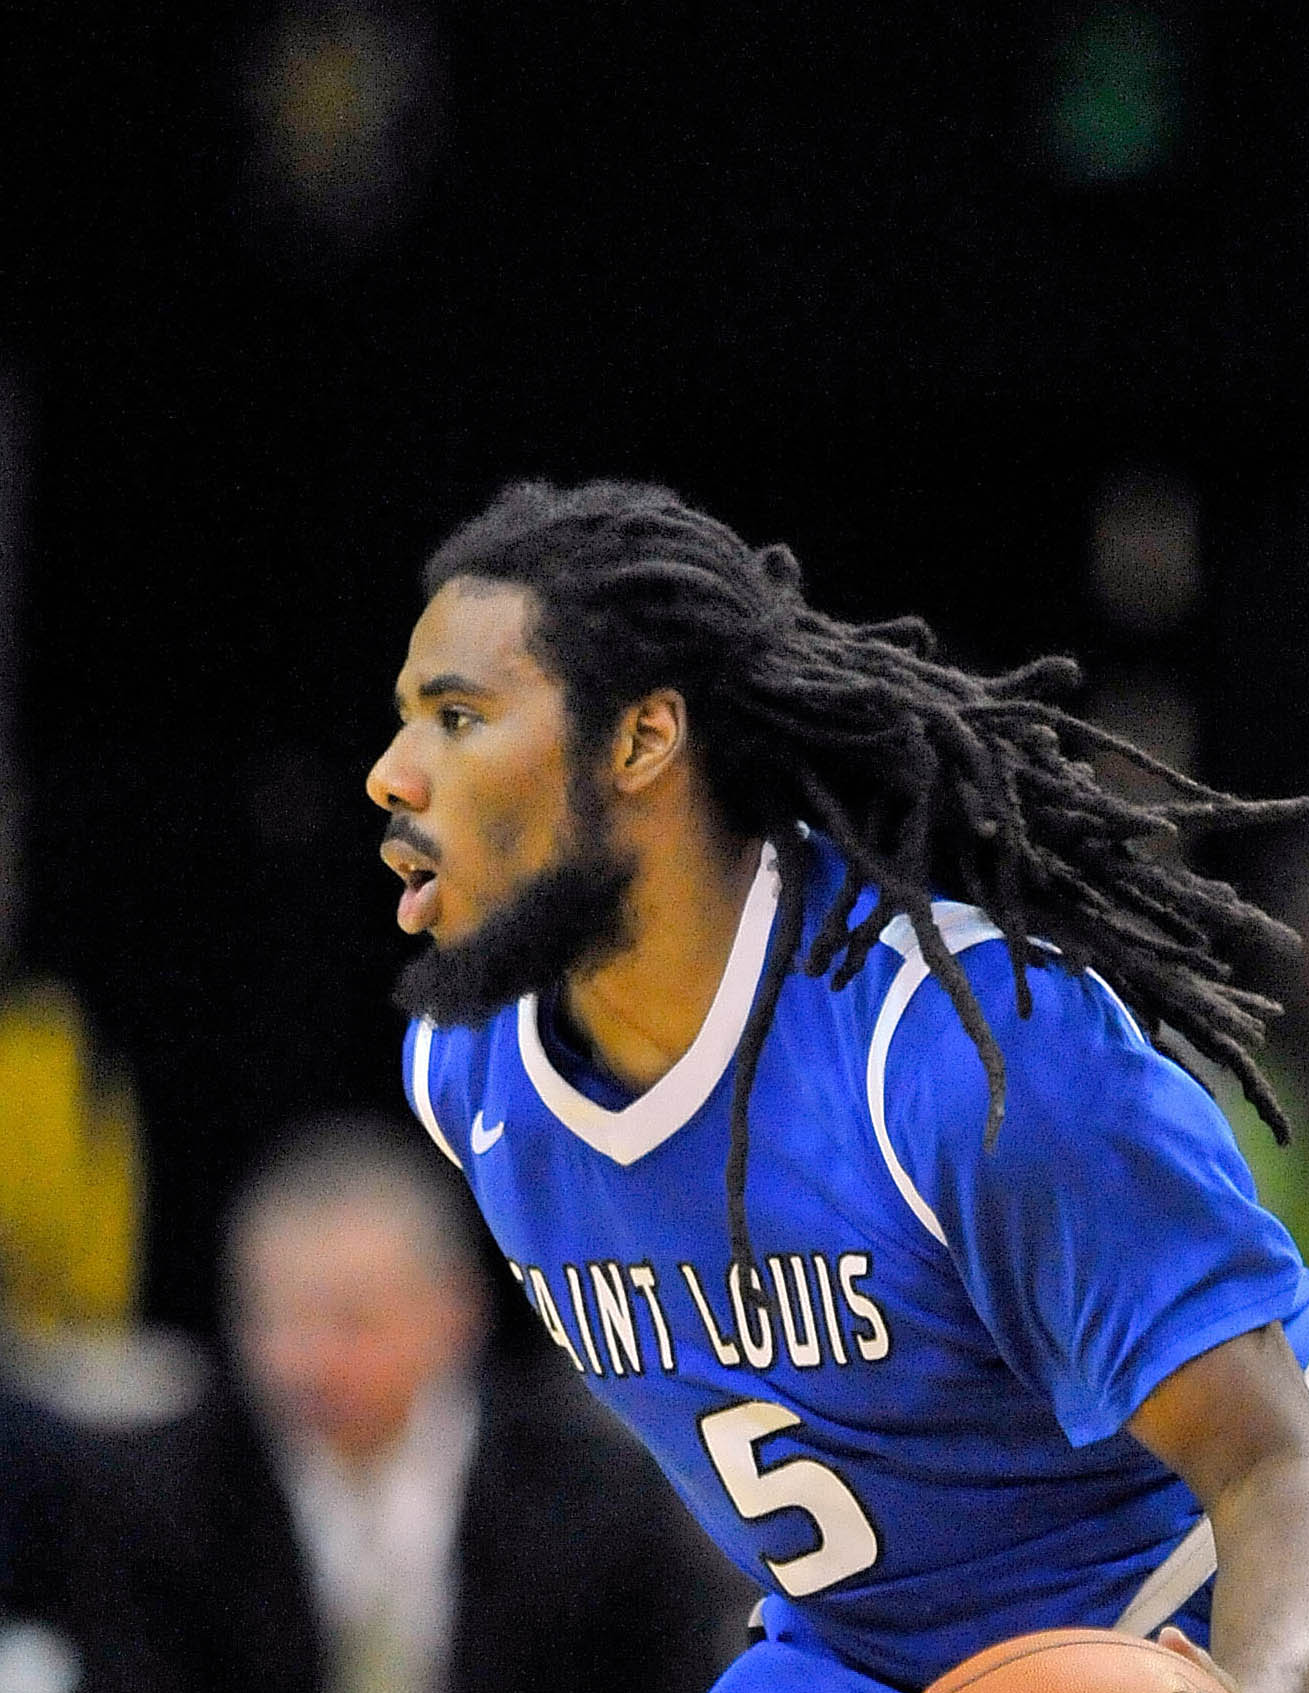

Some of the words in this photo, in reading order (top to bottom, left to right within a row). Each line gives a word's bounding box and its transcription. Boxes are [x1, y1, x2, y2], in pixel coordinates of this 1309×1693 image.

[509, 1260, 675, 1376] AINT
[680, 1252, 891, 1370] LOUIS
[698, 1398, 881, 1600] 5
